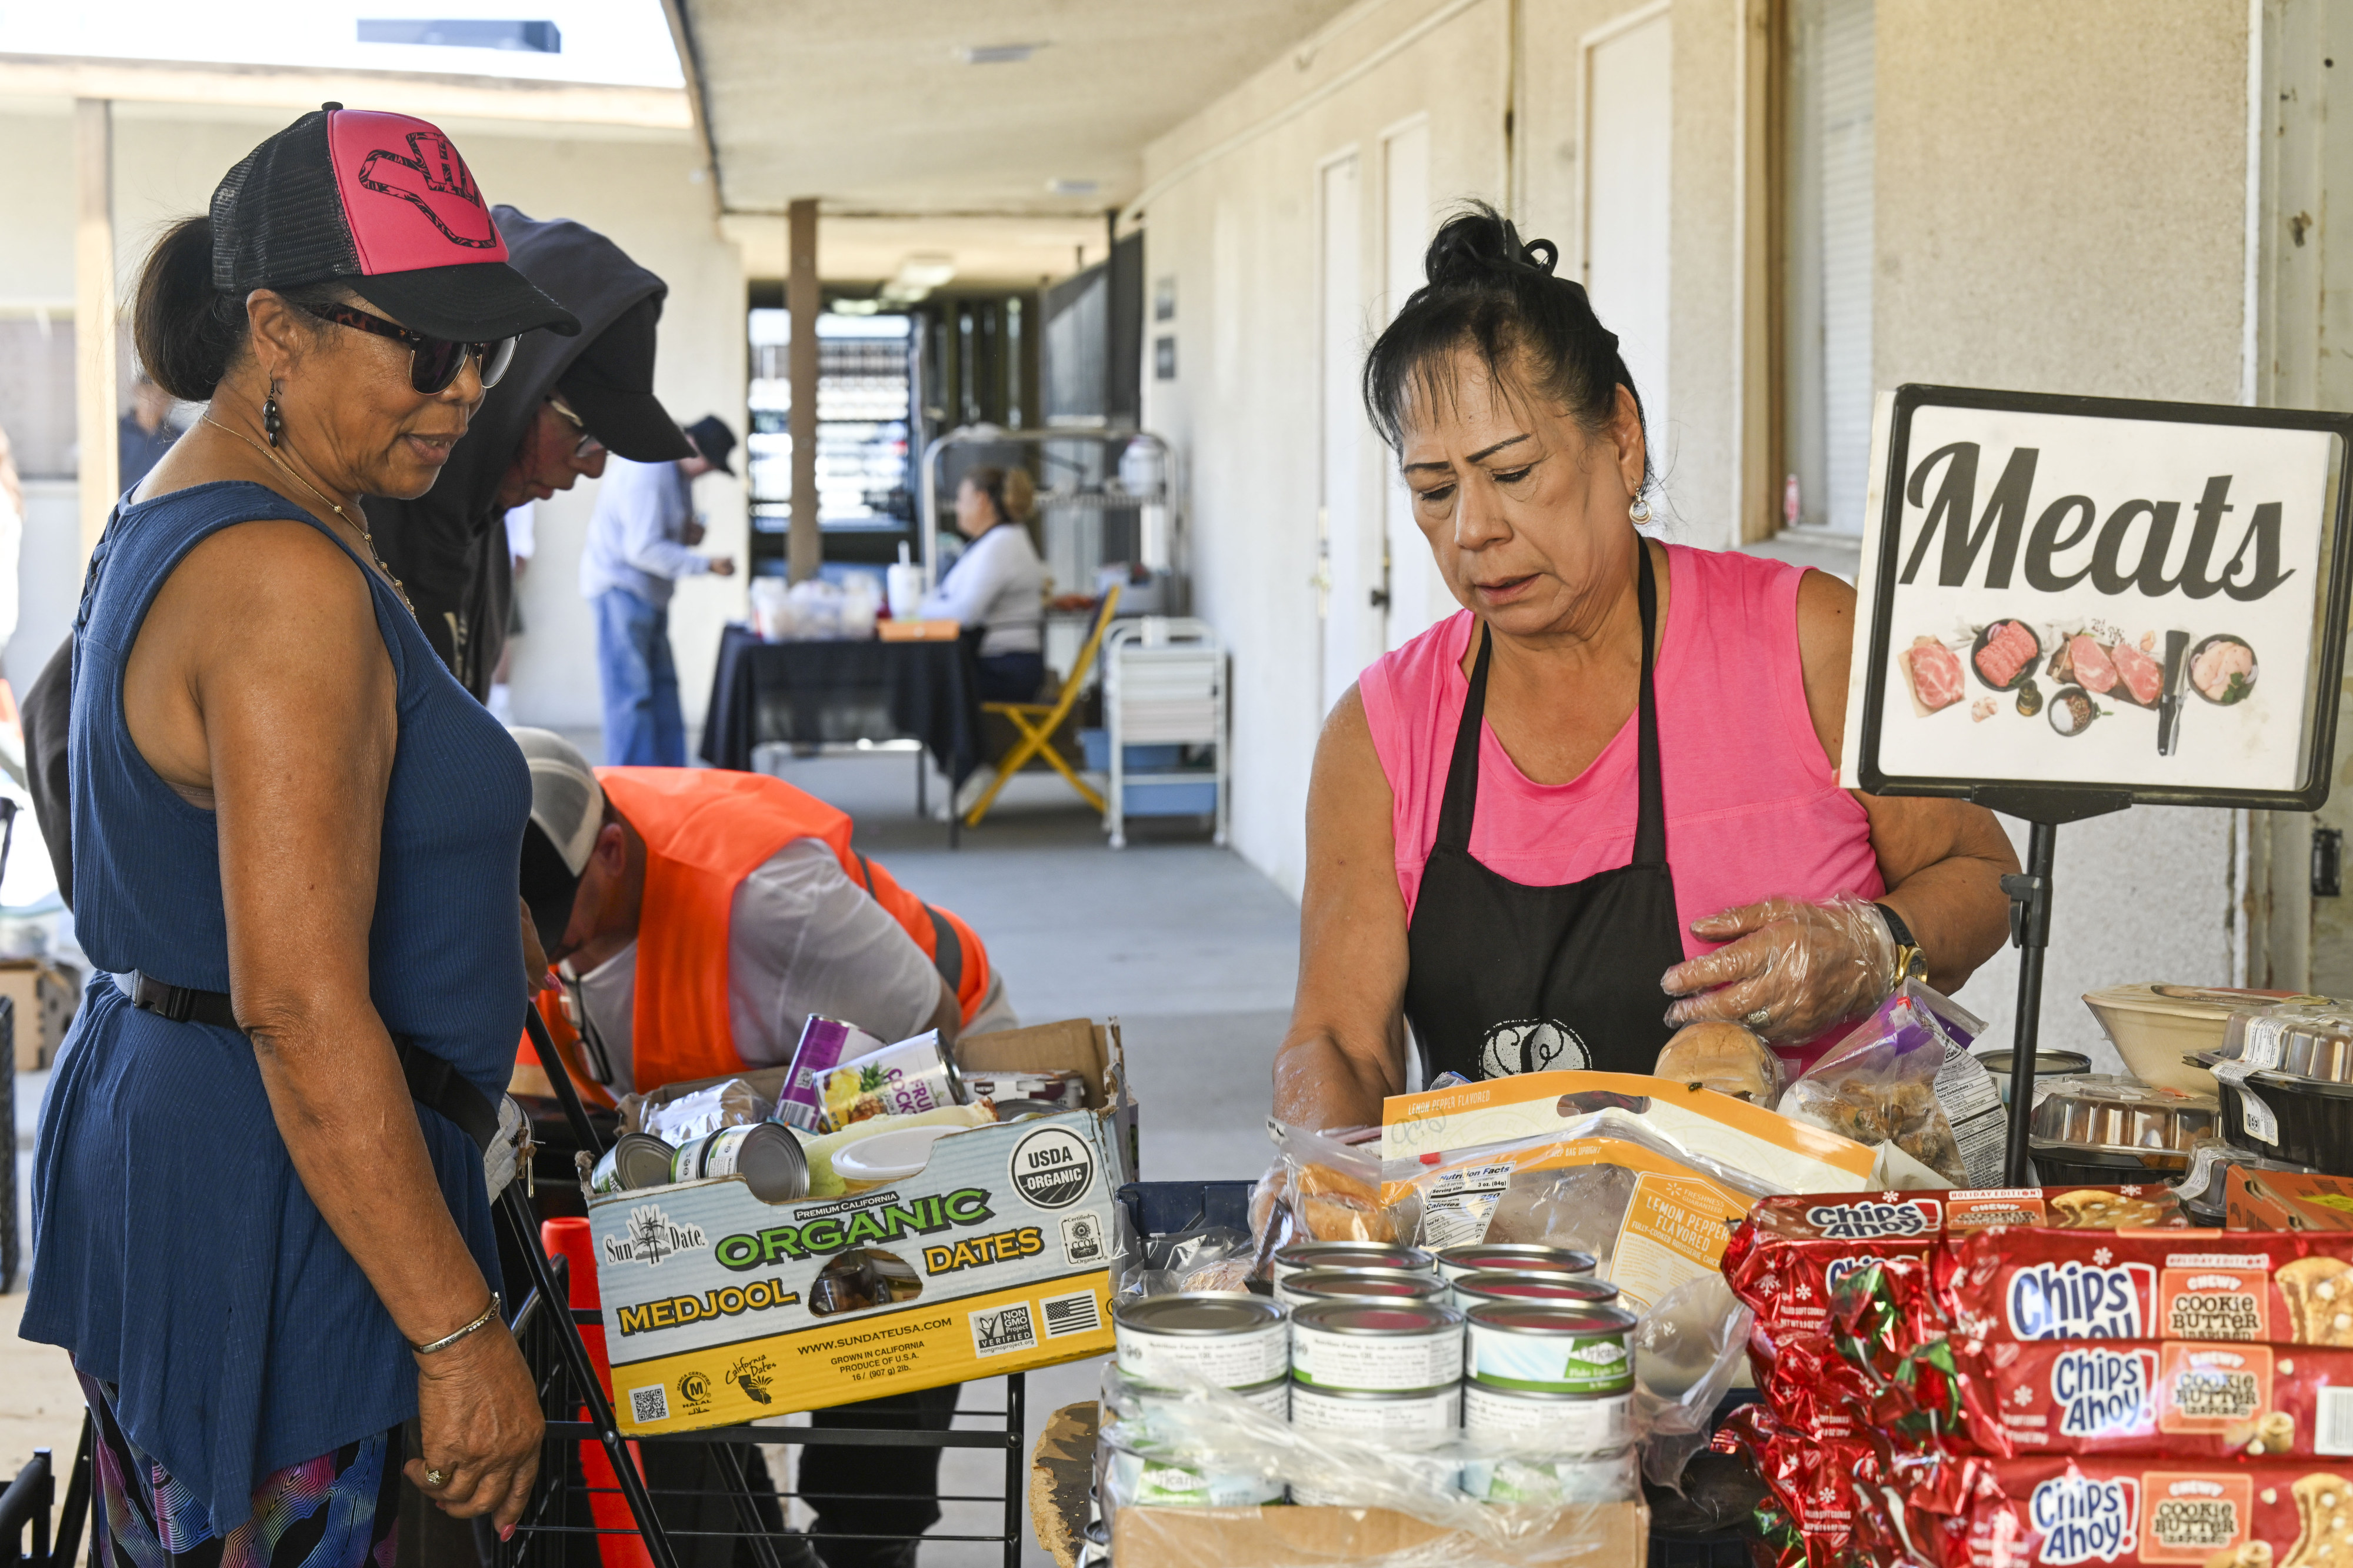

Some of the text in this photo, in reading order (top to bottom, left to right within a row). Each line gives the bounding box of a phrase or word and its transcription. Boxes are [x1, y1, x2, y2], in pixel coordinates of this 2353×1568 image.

[1899, 442, 2296, 601] Meats
[888, 1068, 917, 1114] COCK
[1947, 1085, 1969, 1096] Carbohydrate
[1408, 1090, 1490, 1115] LEMON PEPPER FLAVORED
[1028, 1146, 1073, 1169] USDA
[1565, 1147, 1576, 1156] BAG
[1578, 1145, 1602, 1156] UPRIGHT
[1027, 1167, 1082, 1190] ORGANIC
[1439, 1166, 1510, 1182] Nutriion Facts
[796, 1193, 898, 1220] PREMIUM CALIFORNIA
[1479, 1193, 1501, 1201] 250
[1682, 1196, 1722, 1214] GUARANTEED
[1684, 1189, 1724, 1207] FRESHNESS
[1068, 1213, 1091, 1223] Certified
[1647, 1196, 1730, 1242] LEMON PEPPER
[1811, 1204, 1918, 1226] Chips
[715, 1189, 993, 1269] ORGANIC
[1631, 1220, 1671, 1244] FULLY-COOKED
[1655, 1215, 1711, 1252] FLAVORED
[606, 1237, 634, 1263] Sun
[924, 1227, 1044, 1275] DATES
[1077, 1256, 1097, 1265] Organic
[618, 1279, 798, 1334] MEDJOOL
[2014, 1266, 2128, 1335] Chips
[1003, 1309, 1026, 1320] NON
[1004, 1316, 1028, 1327] GMO
[797, 1317, 952, 1355] WWW.SUNDATEUSA.COM
[981, 1332, 1031, 1347] VERIFIED
[1006, 1324, 1029, 1333] Project
[435, 1335, 457, 1349] HOPE
[831, 1340, 925, 1365] GROWN IN CALIFORNIA
[980, 1339, 1034, 1354] nongmoproject.org
[725, 1354, 767, 1385] California
[750, 1362, 777, 1377] Dates
[840, 1353, 919, 1373] PRODUCE OF U.S.A.
[869, 1369, 885, 1380] (907
[886, 1367, 895, 1377] g)
[896, 1365, 911, 1373] 2lb.
[688, 1371, 711, 1386] CERTIFIED
[2057, 1354, 2138, 1400] Chips
[682, 1400, 712, 1408] HALAL
[2037, 1481, 2118, 1527] Chips
